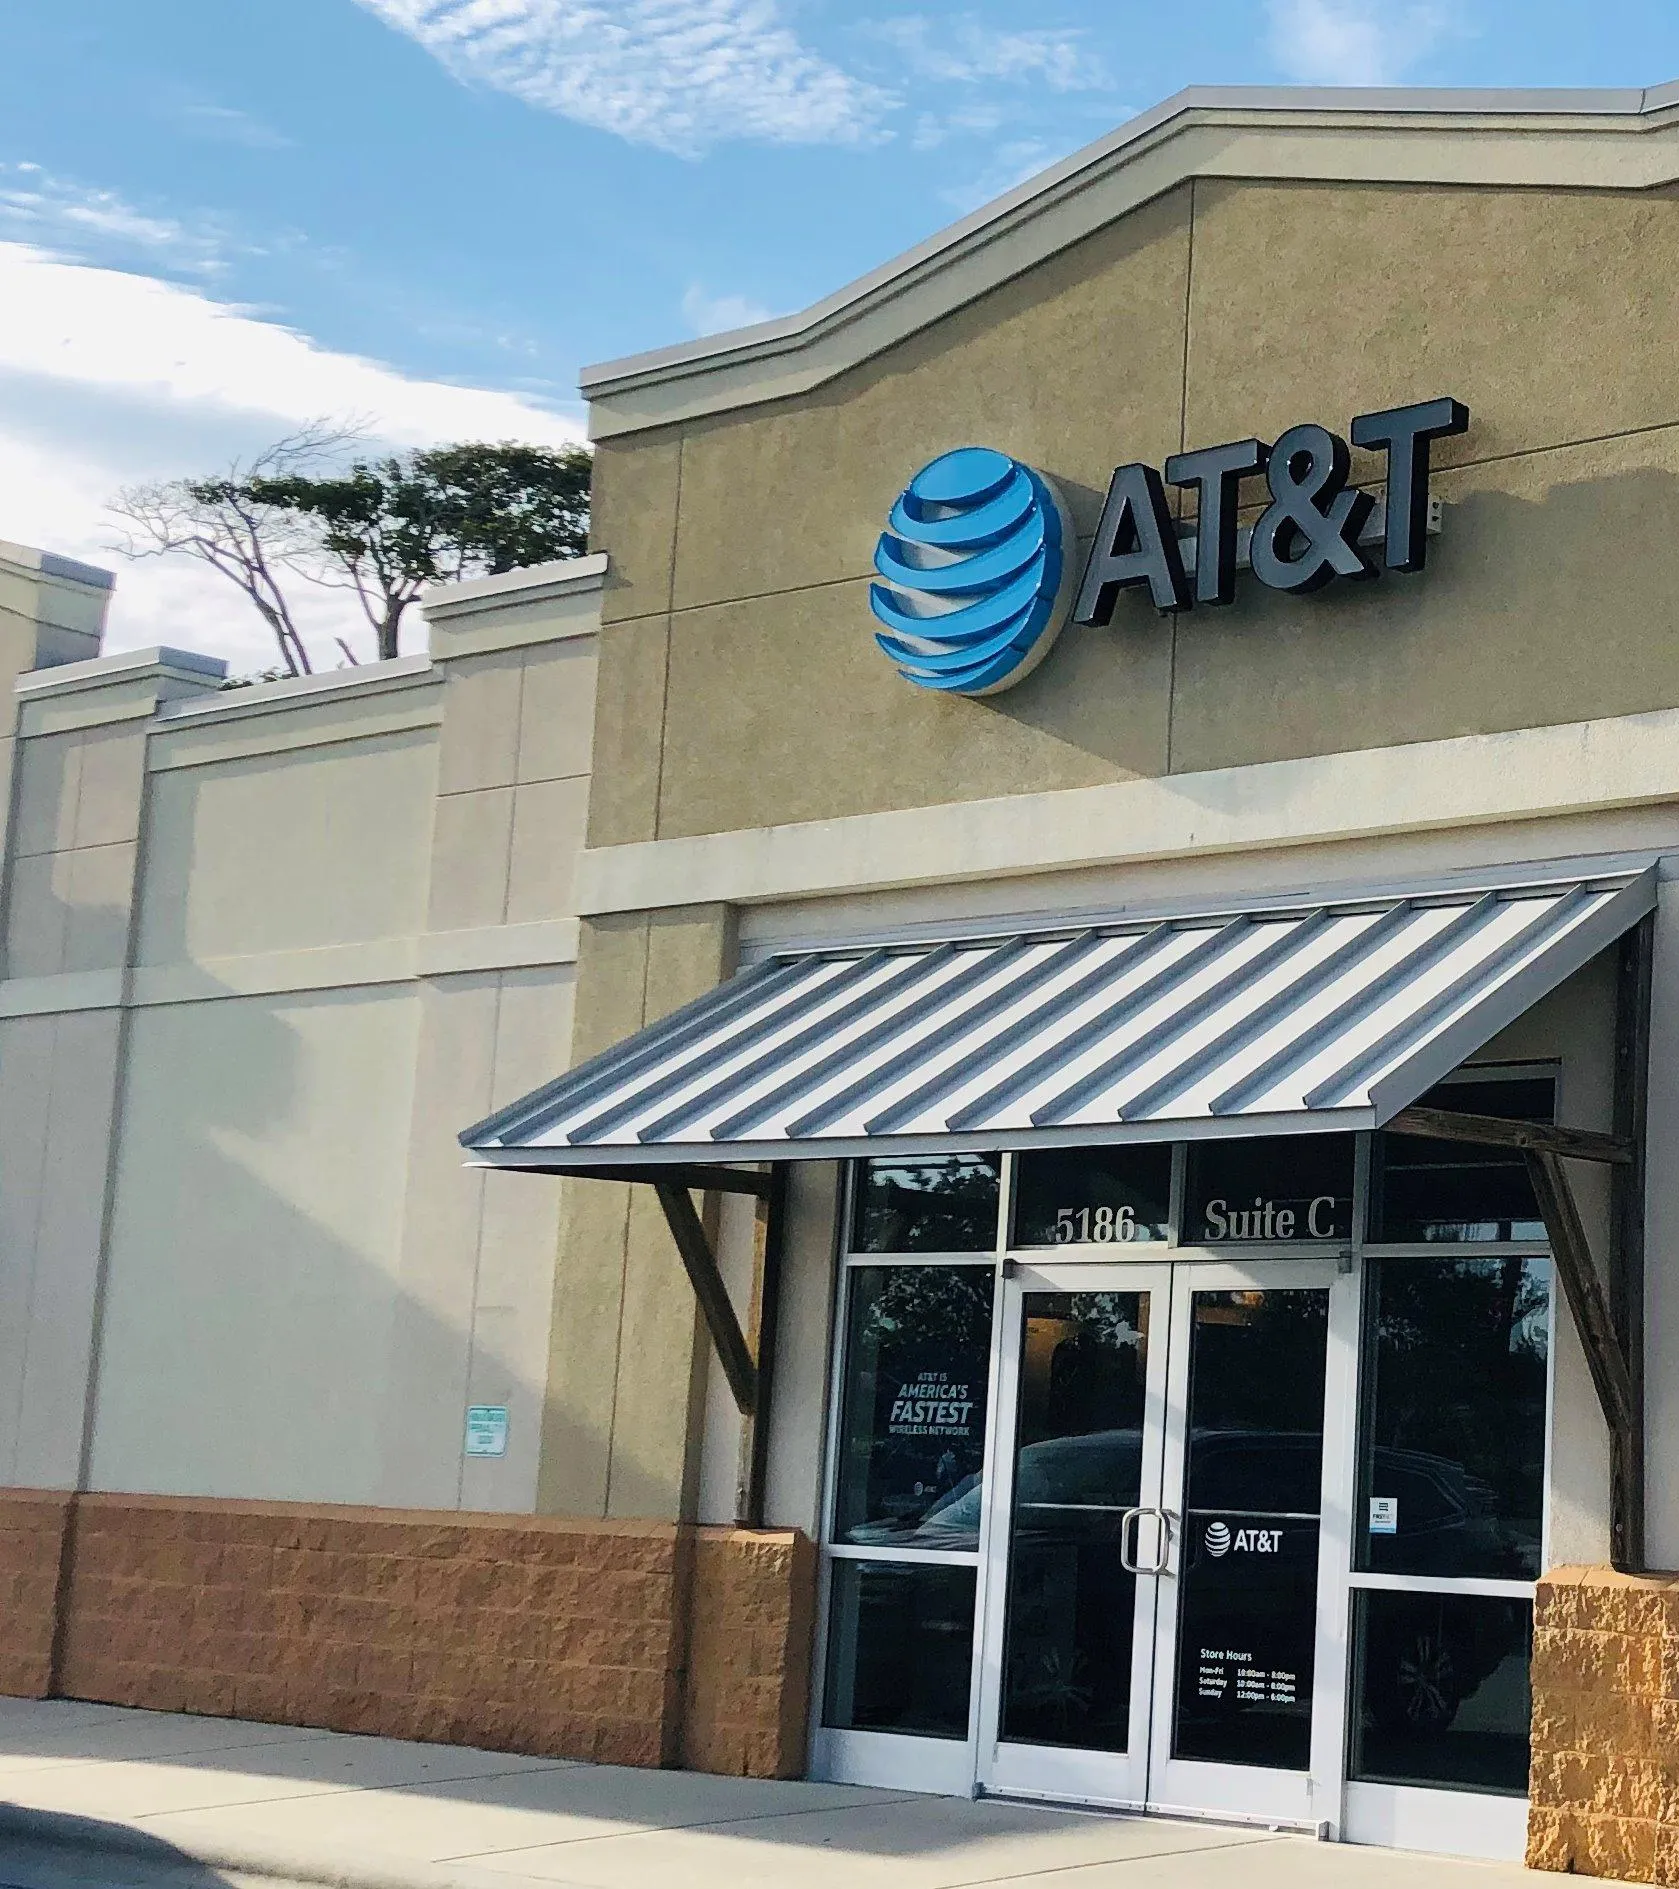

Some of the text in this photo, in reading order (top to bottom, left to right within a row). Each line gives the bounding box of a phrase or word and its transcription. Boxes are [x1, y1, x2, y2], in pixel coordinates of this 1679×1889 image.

[1073, 397, 1469, 628] AT&T
[1055, 1205, 1135, 1244] 5186
[1204, 1196, 1335, 1241] Suite C
[897, 1383, 969, 1400] AMERICA'S
[890, 1400, 974, 1424] FASTEST
[888, 1424, 970, 1436] WIRELESS NETWORK
[1233, 1529, 1283, 1552] AT&T
[1201, 1648, 1252, 1661] Store Hours
[1199, 1677, 1228, 1688] Saturday
[1199, 1688, 1222, 1699] Sunday
